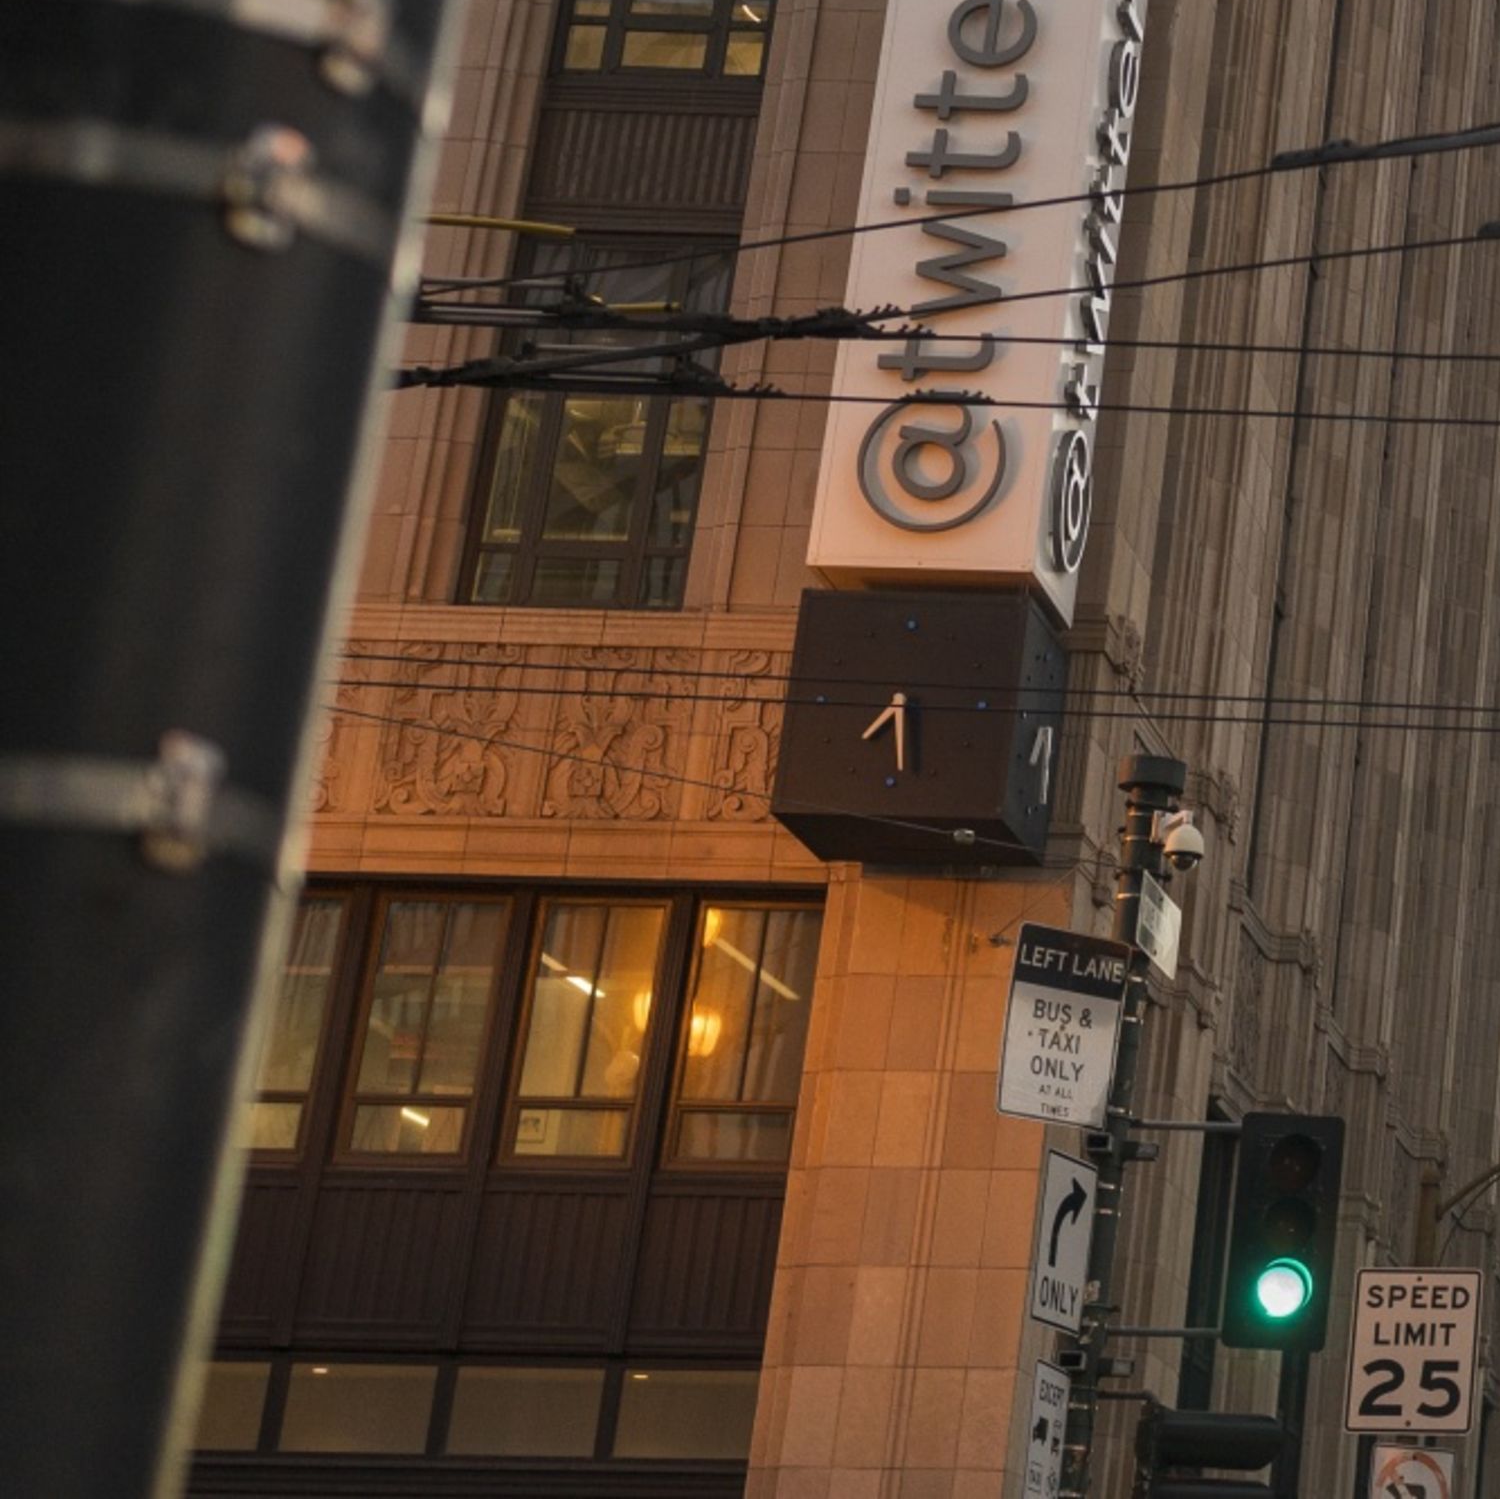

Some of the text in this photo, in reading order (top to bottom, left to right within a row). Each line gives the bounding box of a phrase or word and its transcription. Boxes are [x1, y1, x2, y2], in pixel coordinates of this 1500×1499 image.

[1020, 943, 1124, 983] LEFT LANE
[1033, 999, 1092, 1029] BUS &
[1039, 1028, 1081, 1055] TAXI
[1030, 1055, 1084, 1082] ONLY
[1041, 1103, 1070, 1117] TIMES
[1040, 1275, 1079, 1317] ONLY
[1366, 1285, 1470, 1309] SPEED
[1373, 1321, 1456, 1347] LIMIT
[1358, 1358, 1461, 1418] 25
